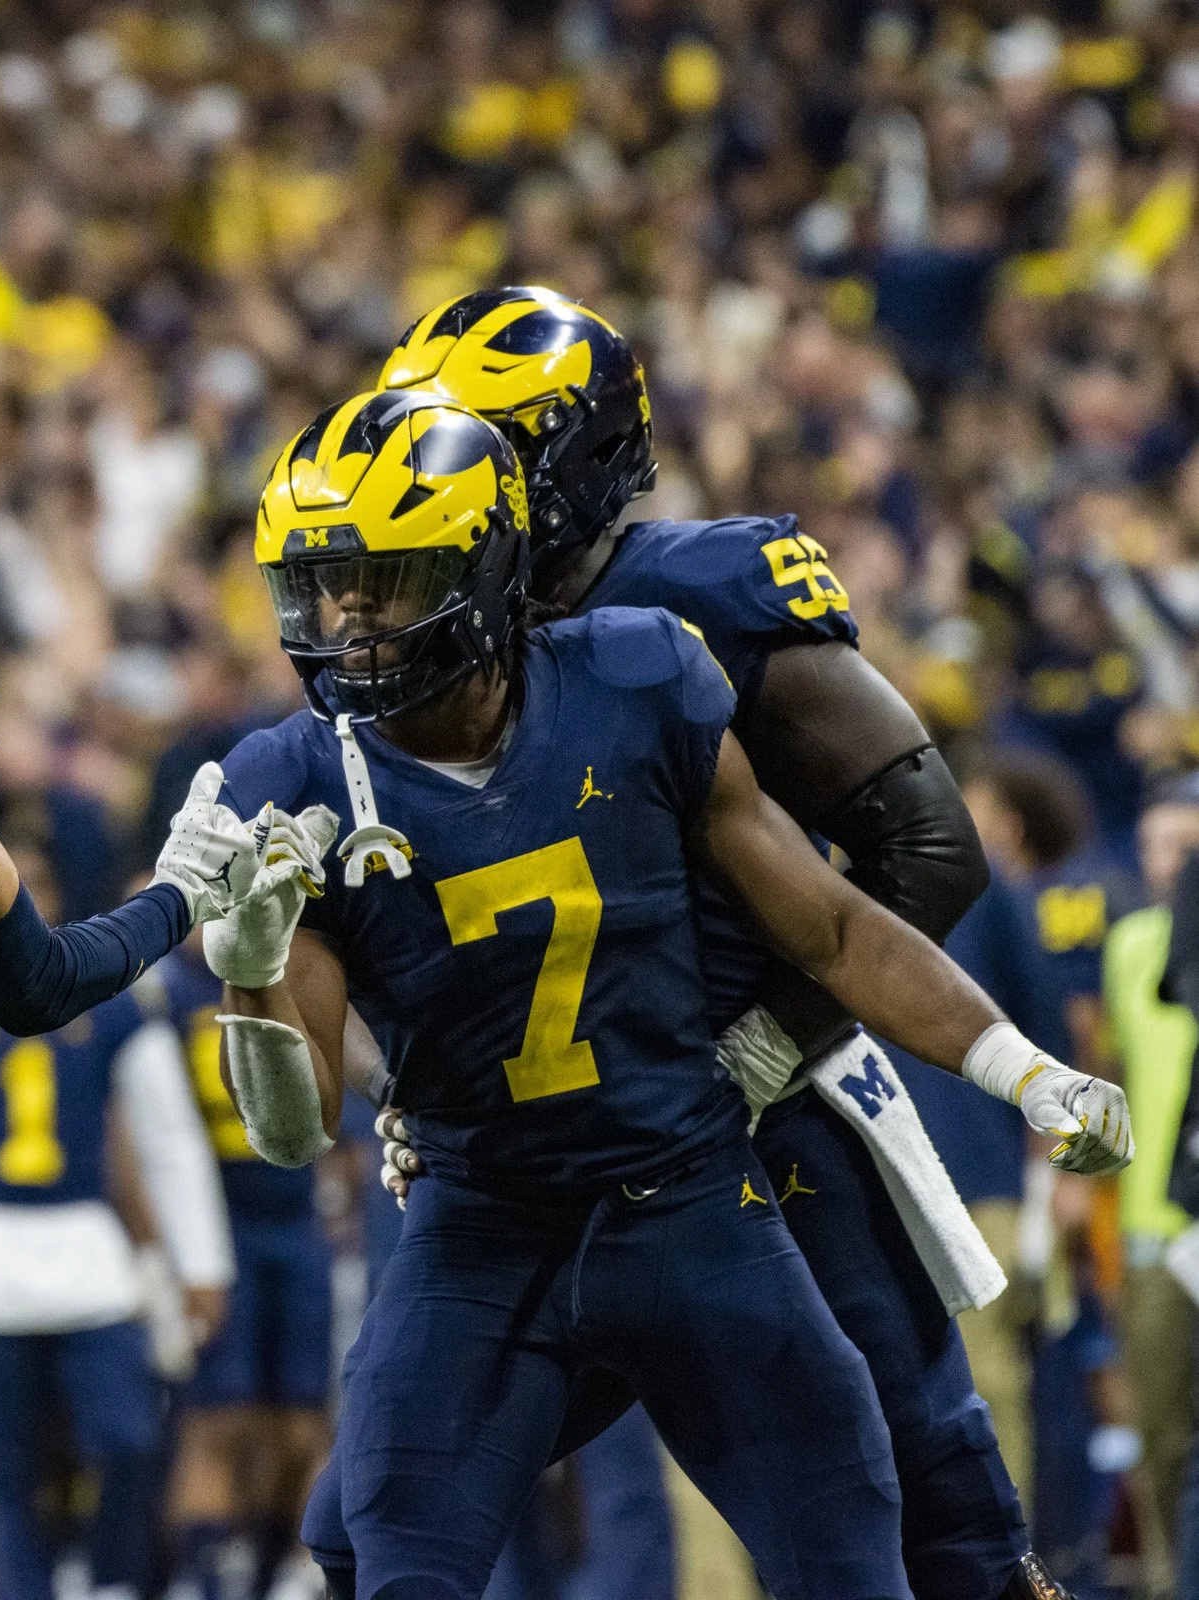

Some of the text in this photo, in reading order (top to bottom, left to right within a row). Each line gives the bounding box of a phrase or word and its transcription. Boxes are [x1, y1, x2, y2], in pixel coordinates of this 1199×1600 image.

[305, 527, 329, 548] M
[435, 836, 603, 1102] 7
[838, 1053, 896, 1120] M
